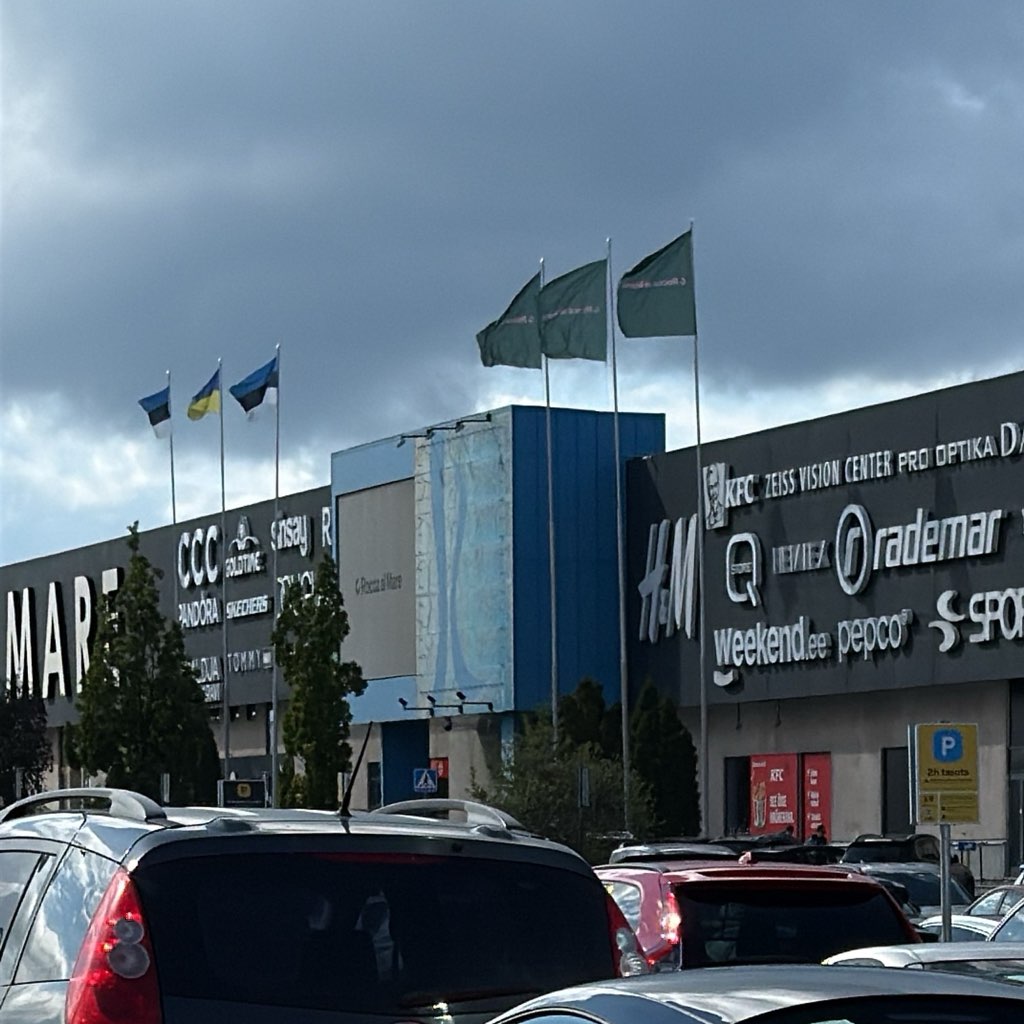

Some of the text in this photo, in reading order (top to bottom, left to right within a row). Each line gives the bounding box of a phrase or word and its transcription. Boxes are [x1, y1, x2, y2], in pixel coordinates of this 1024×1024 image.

[765, 450, 893, 499] ZEISS VISION CENTER
[898, 436, 994, 473] PRO OPTIKA
[725, 474, 755, 508] KFC
[178, 525, 219, 589] CCC
[873, 508, 1004, 571] rademar
[637, 513, 698, 643] H&M
[179, 594, 220, 629] PANDORA
[227, 649, 262, 672] TOMMY
[714, 616, 828, 667] weekend.ee
[838, 614, 902, 663] pepco
[927, 767, 940, 777] 2h
